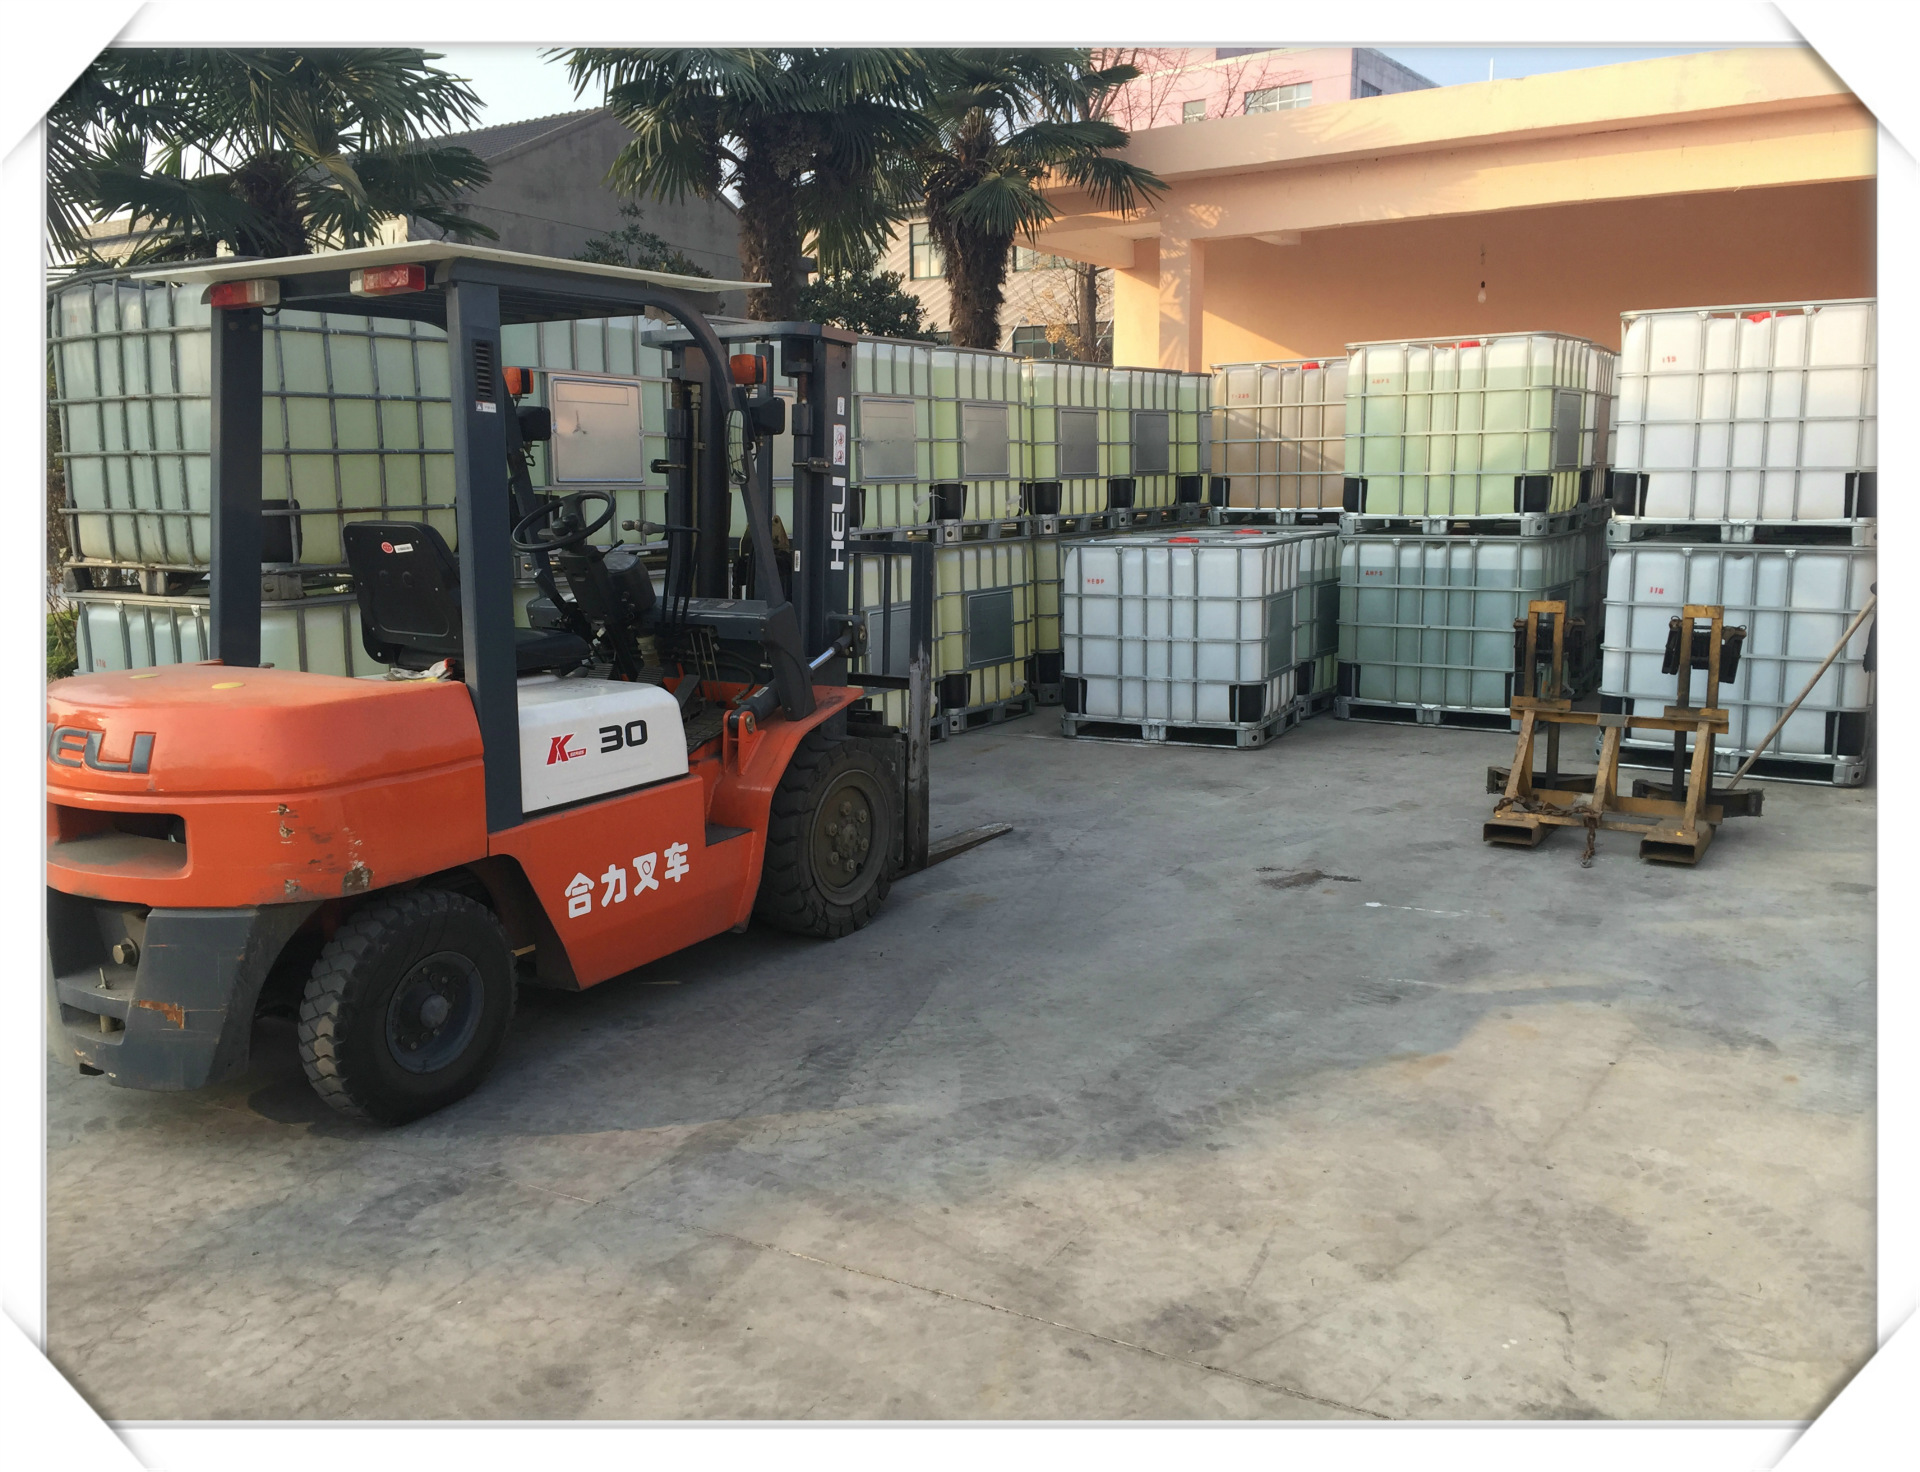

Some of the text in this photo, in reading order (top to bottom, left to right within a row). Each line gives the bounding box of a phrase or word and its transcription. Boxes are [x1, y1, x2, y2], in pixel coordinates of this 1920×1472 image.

[831, 476, 846, 570] HELI
[46, 722, 155, 774] ELI
[546, 733, 575, 766] K
[598, 719, 648, 754] 30
[564, 842, 690, 919] 合力叉车
